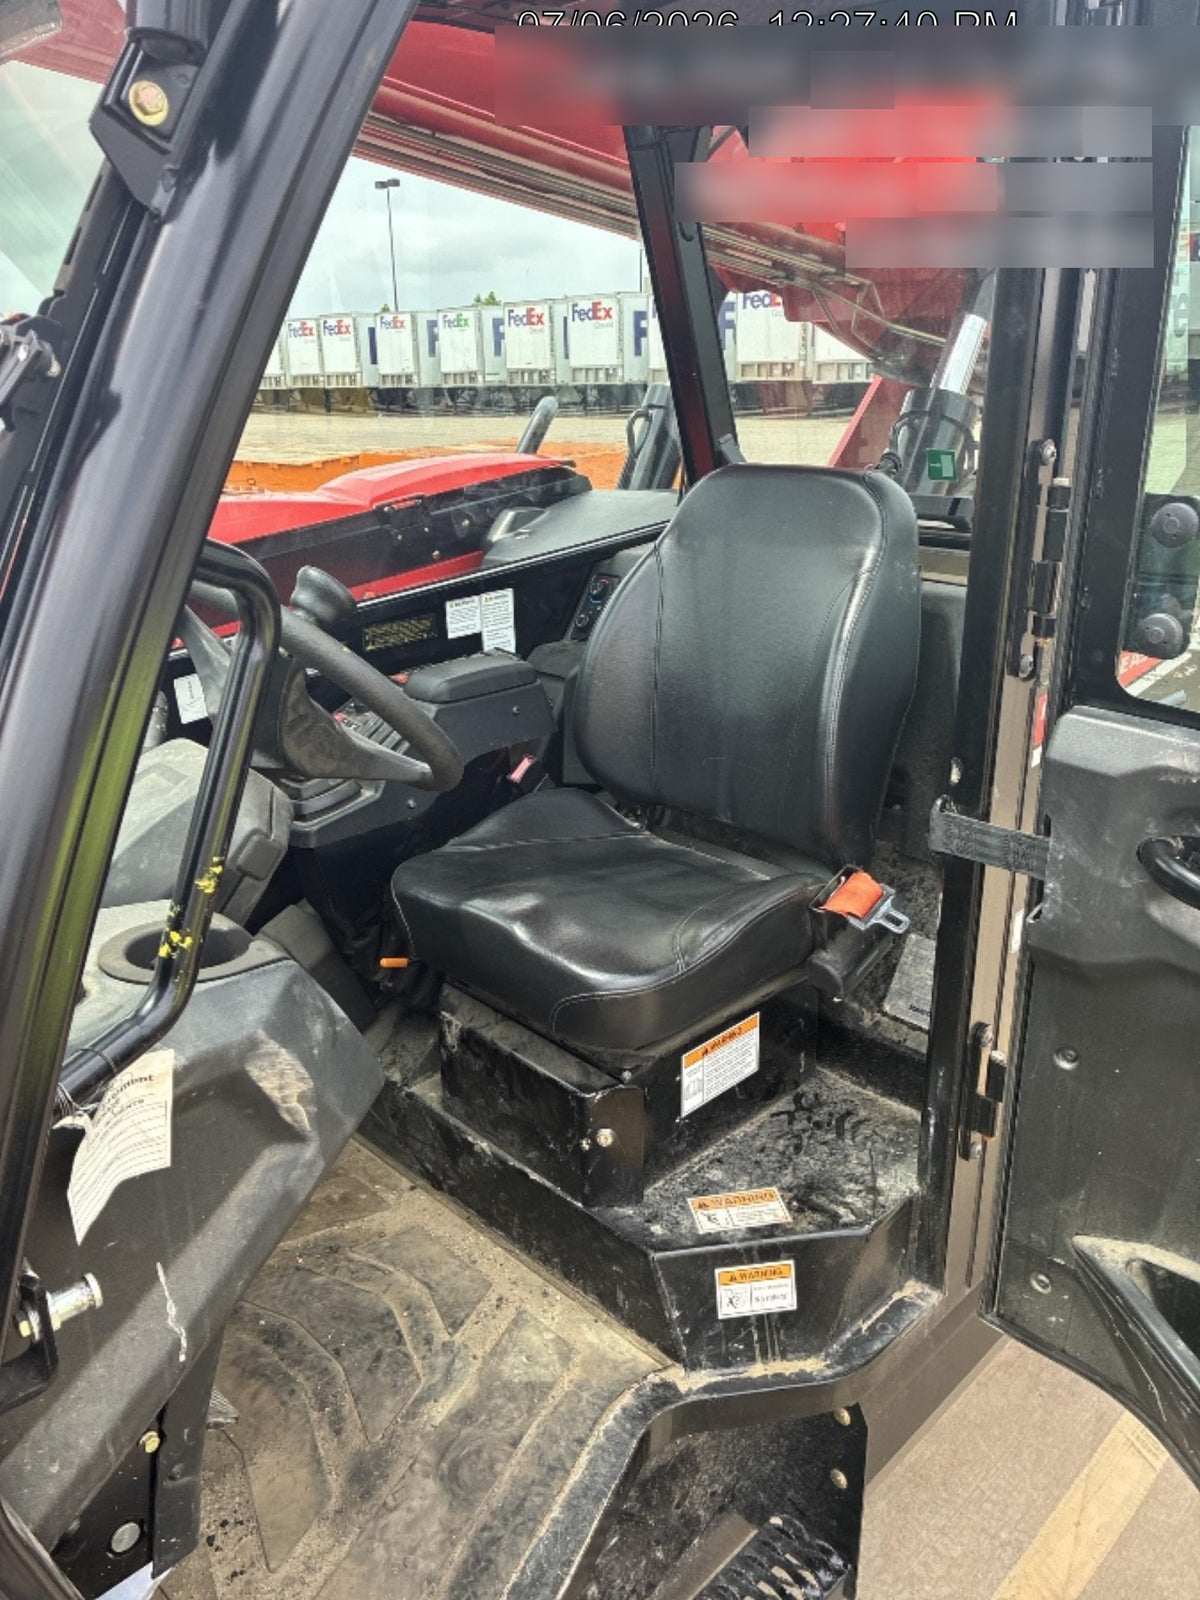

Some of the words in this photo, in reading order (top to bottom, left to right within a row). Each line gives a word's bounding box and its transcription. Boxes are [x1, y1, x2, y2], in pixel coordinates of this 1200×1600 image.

[508, 306, 545, 327] FedEx
[571, 301, 613, 322] FedEx
[287, 321, 315, 338] FedEx
[323, 318, 351, 336] FedEx
[379, 315, 406, 329] FedEx
[442, 313, 469, 329] FedEx
